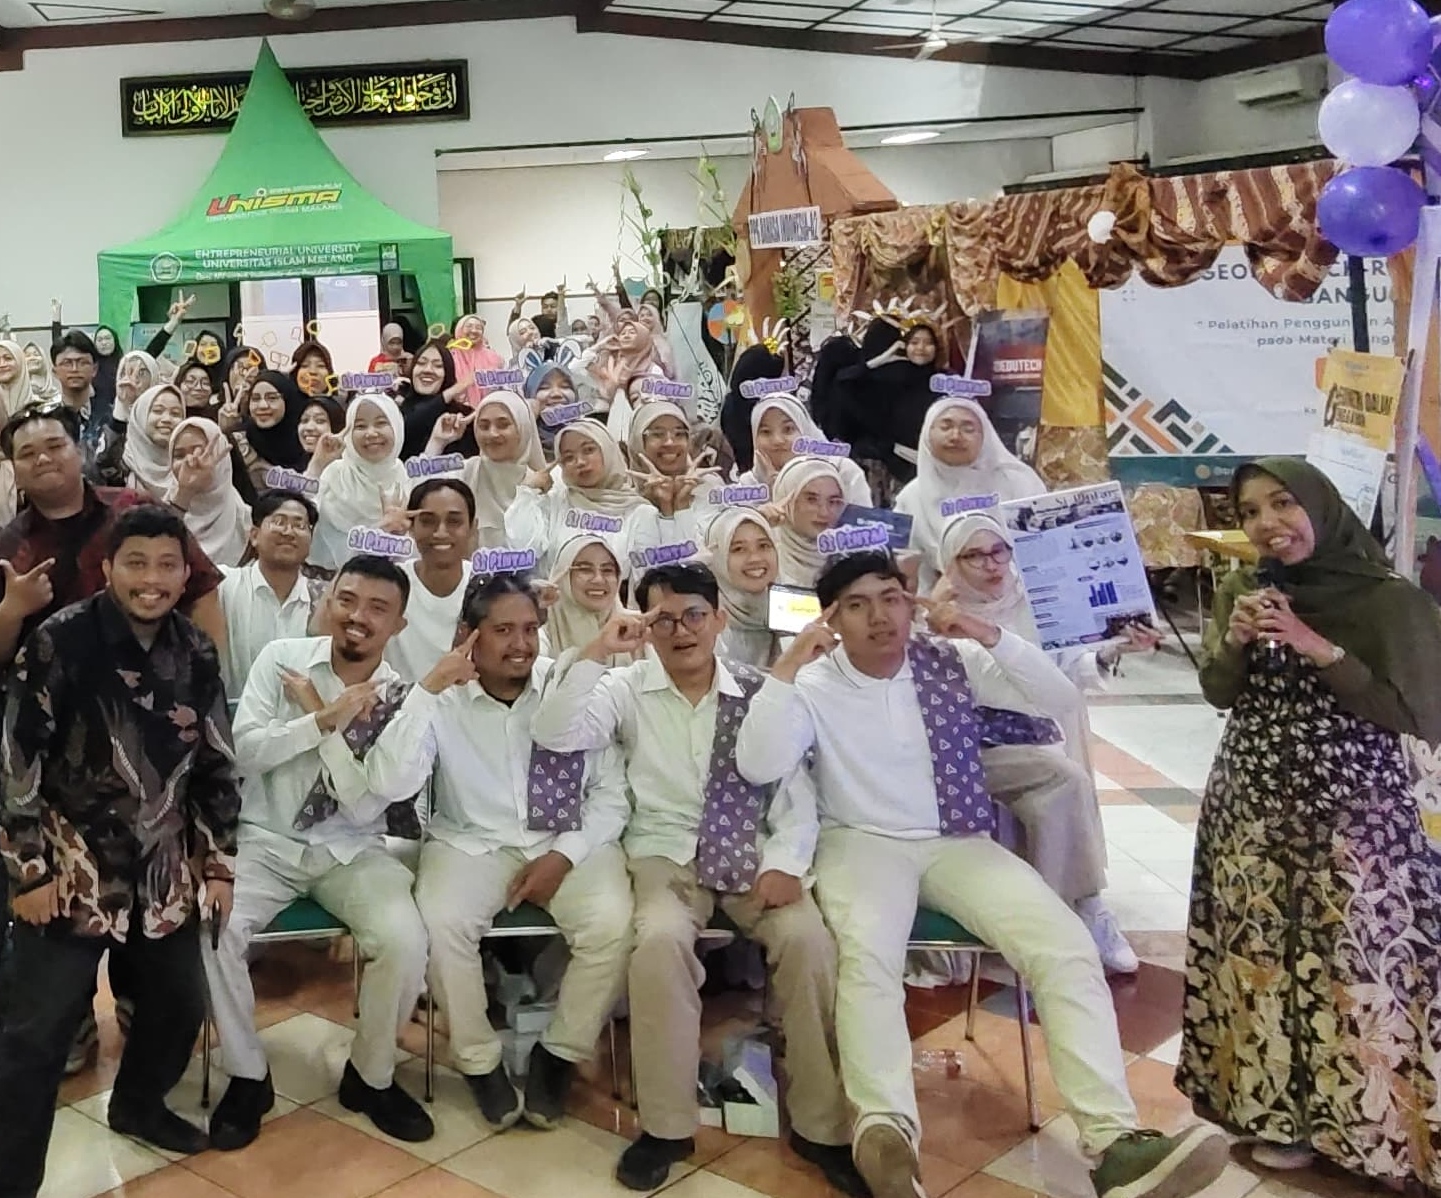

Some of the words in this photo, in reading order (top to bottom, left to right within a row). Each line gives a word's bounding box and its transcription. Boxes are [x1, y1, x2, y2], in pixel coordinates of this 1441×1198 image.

[195, 246, 294, 260] ENTREPRENEURIAL
[297, 242, 361, 255] UNIVERSITY
[203, 257, 271, 269] UNIVERSITAS
[273, 256, 306, 266] ISLAM
[307, 253, 354, 265] MALANG
